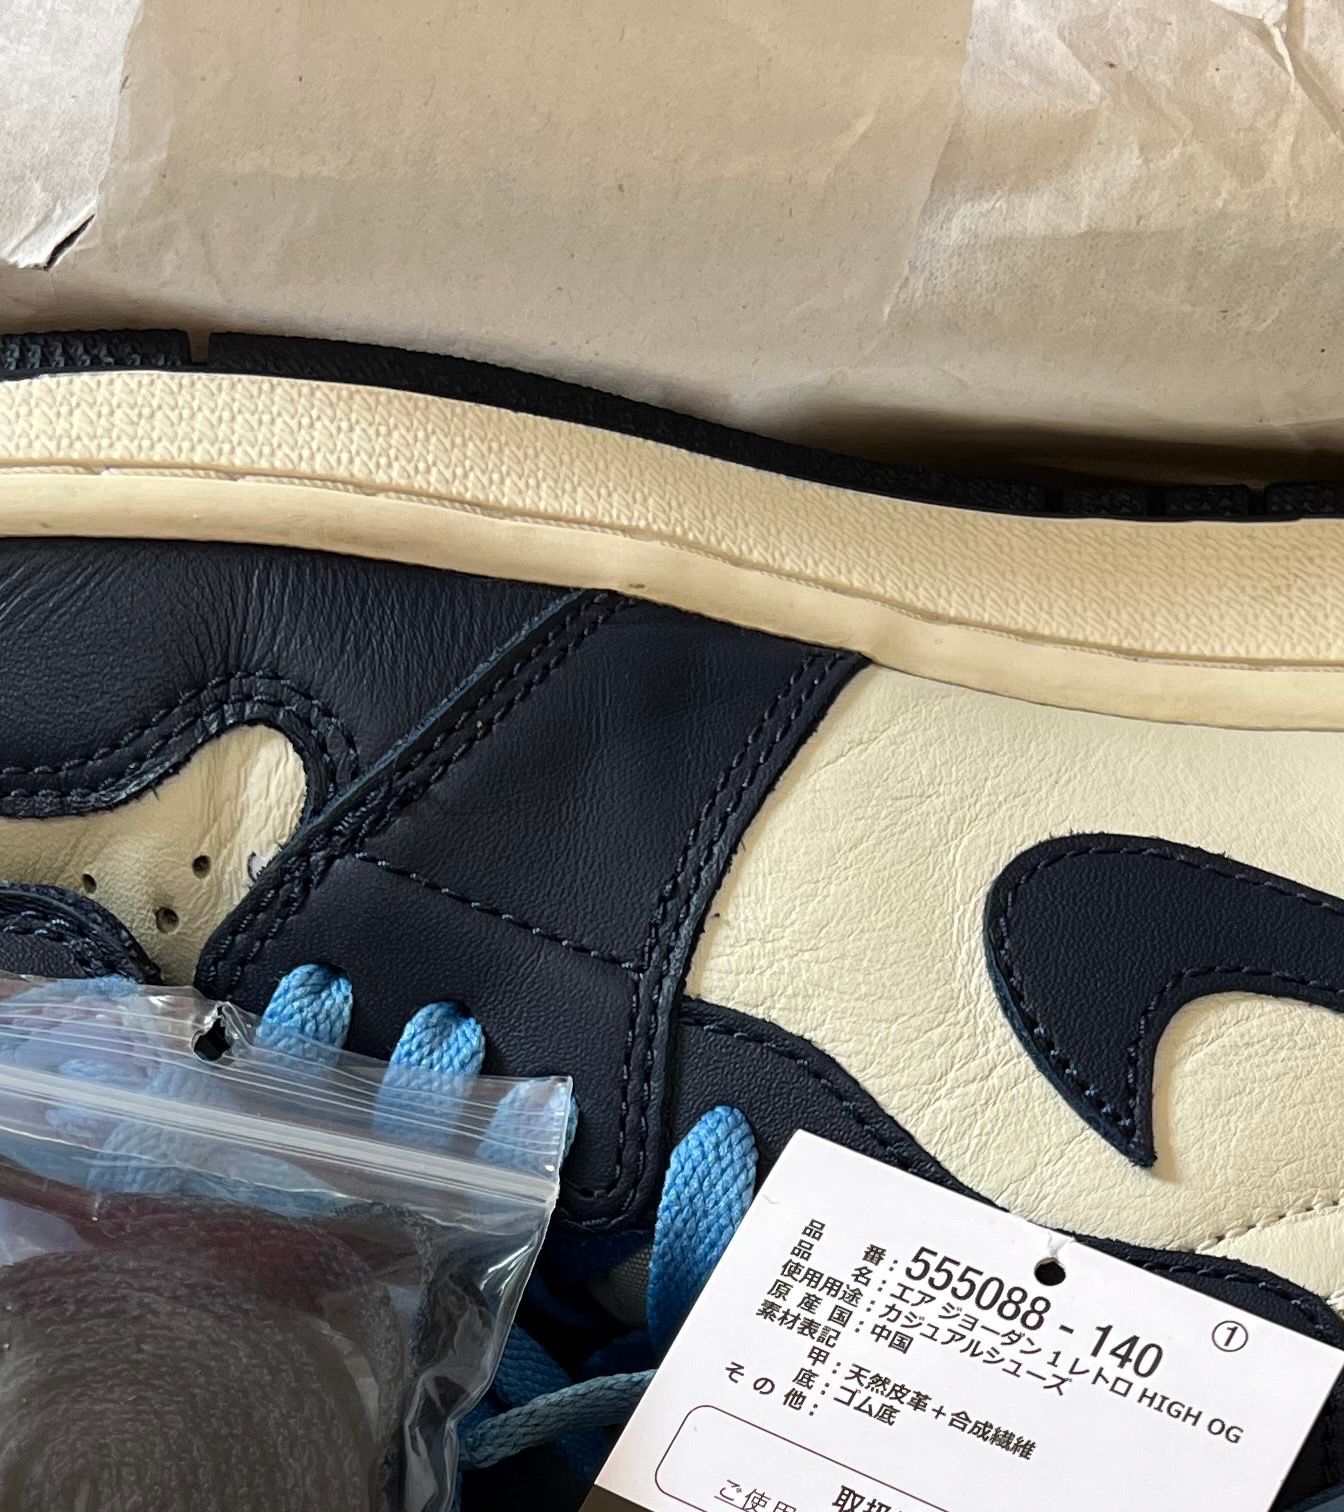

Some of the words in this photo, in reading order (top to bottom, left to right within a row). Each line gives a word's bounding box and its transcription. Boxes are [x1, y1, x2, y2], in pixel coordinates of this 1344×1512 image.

[756, 1299, 841, 1348] 素材表記
[871, 1324, 913, 1354] 中国
[906, 1247, 1051, 1330] 555088
[1091, 1325, 1163, 1377] 140
[879, 1304, 1072, 1395] カジュアルシューズ
[890, 1283, 936, 1306] エア
[938, 1303, 1041, 1354] ジョーダン
[1047, 1351, 1061, 1367] 1
[1069, 1358, 1133, 1397] レトロ
[1138, 1388, 1202, 1426] HIGH
[1208, 1419, 1243, 1443] OG
[834, 1386, 900, 1426] ゴム底
